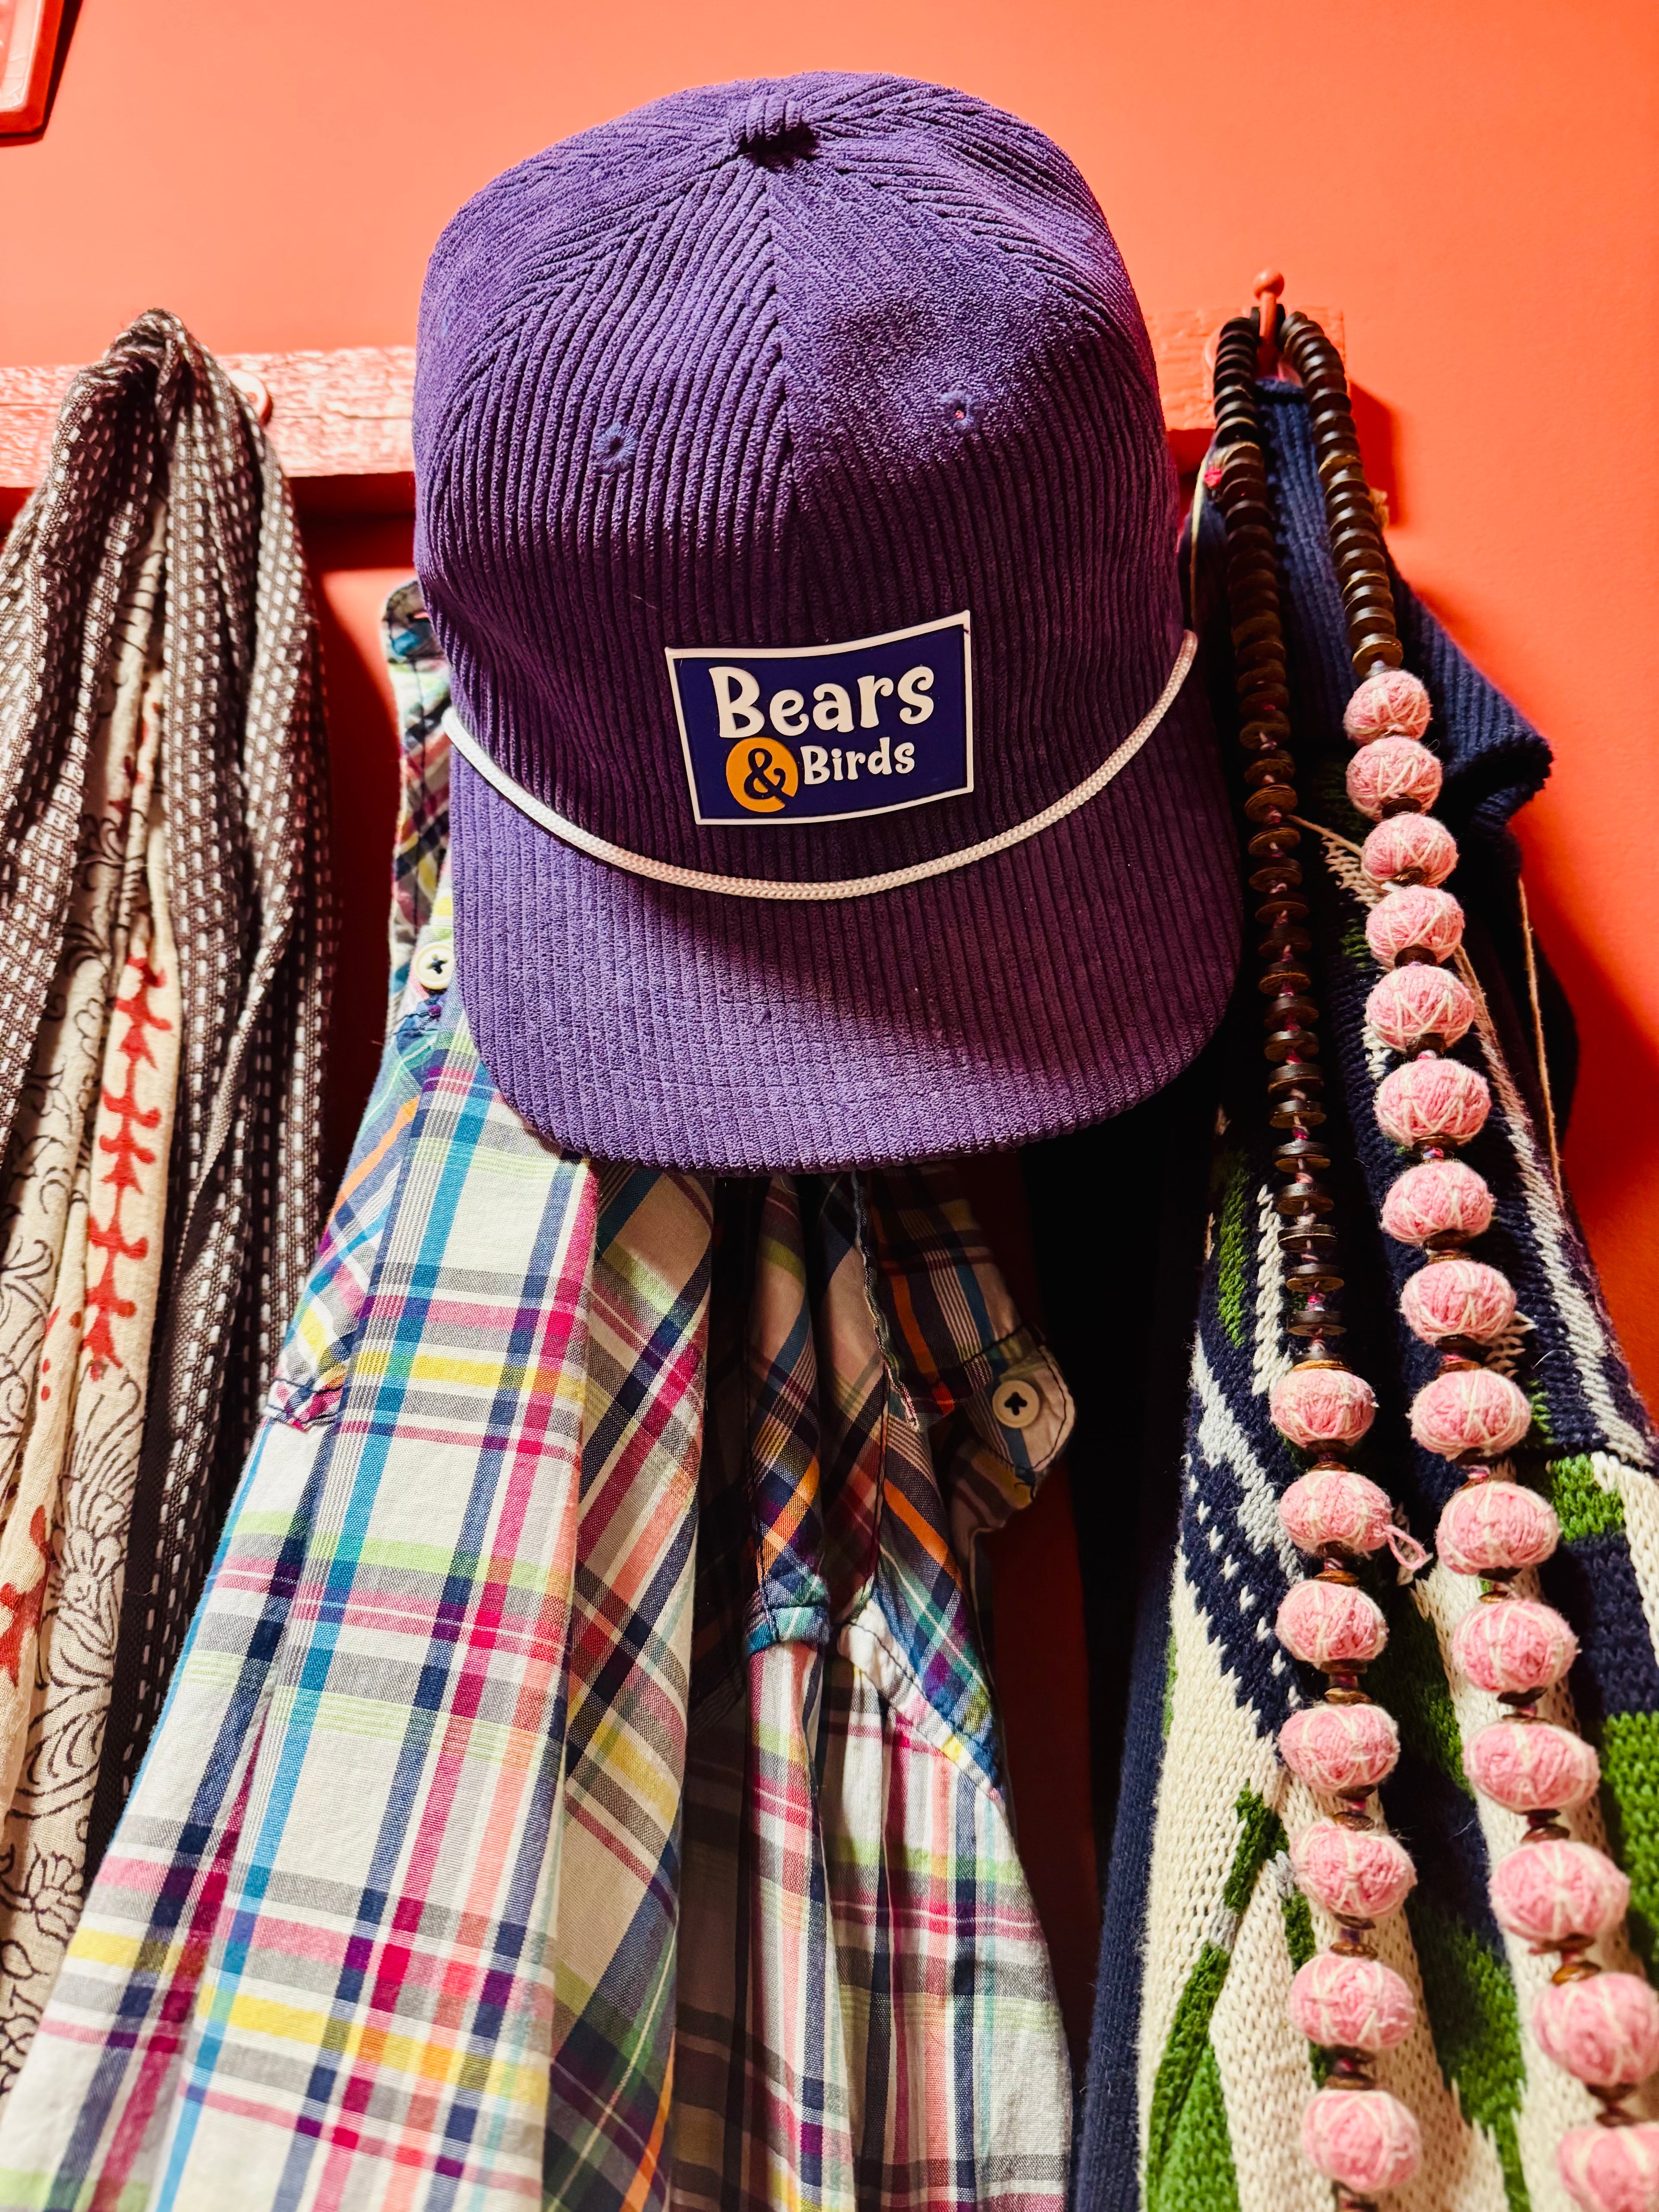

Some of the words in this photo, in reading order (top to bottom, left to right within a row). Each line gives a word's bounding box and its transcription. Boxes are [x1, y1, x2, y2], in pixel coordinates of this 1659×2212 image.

[709, 666, 934, 738] Bears
[744, 747, 795, 804] &
[800, 737, 915, 785] Birds
